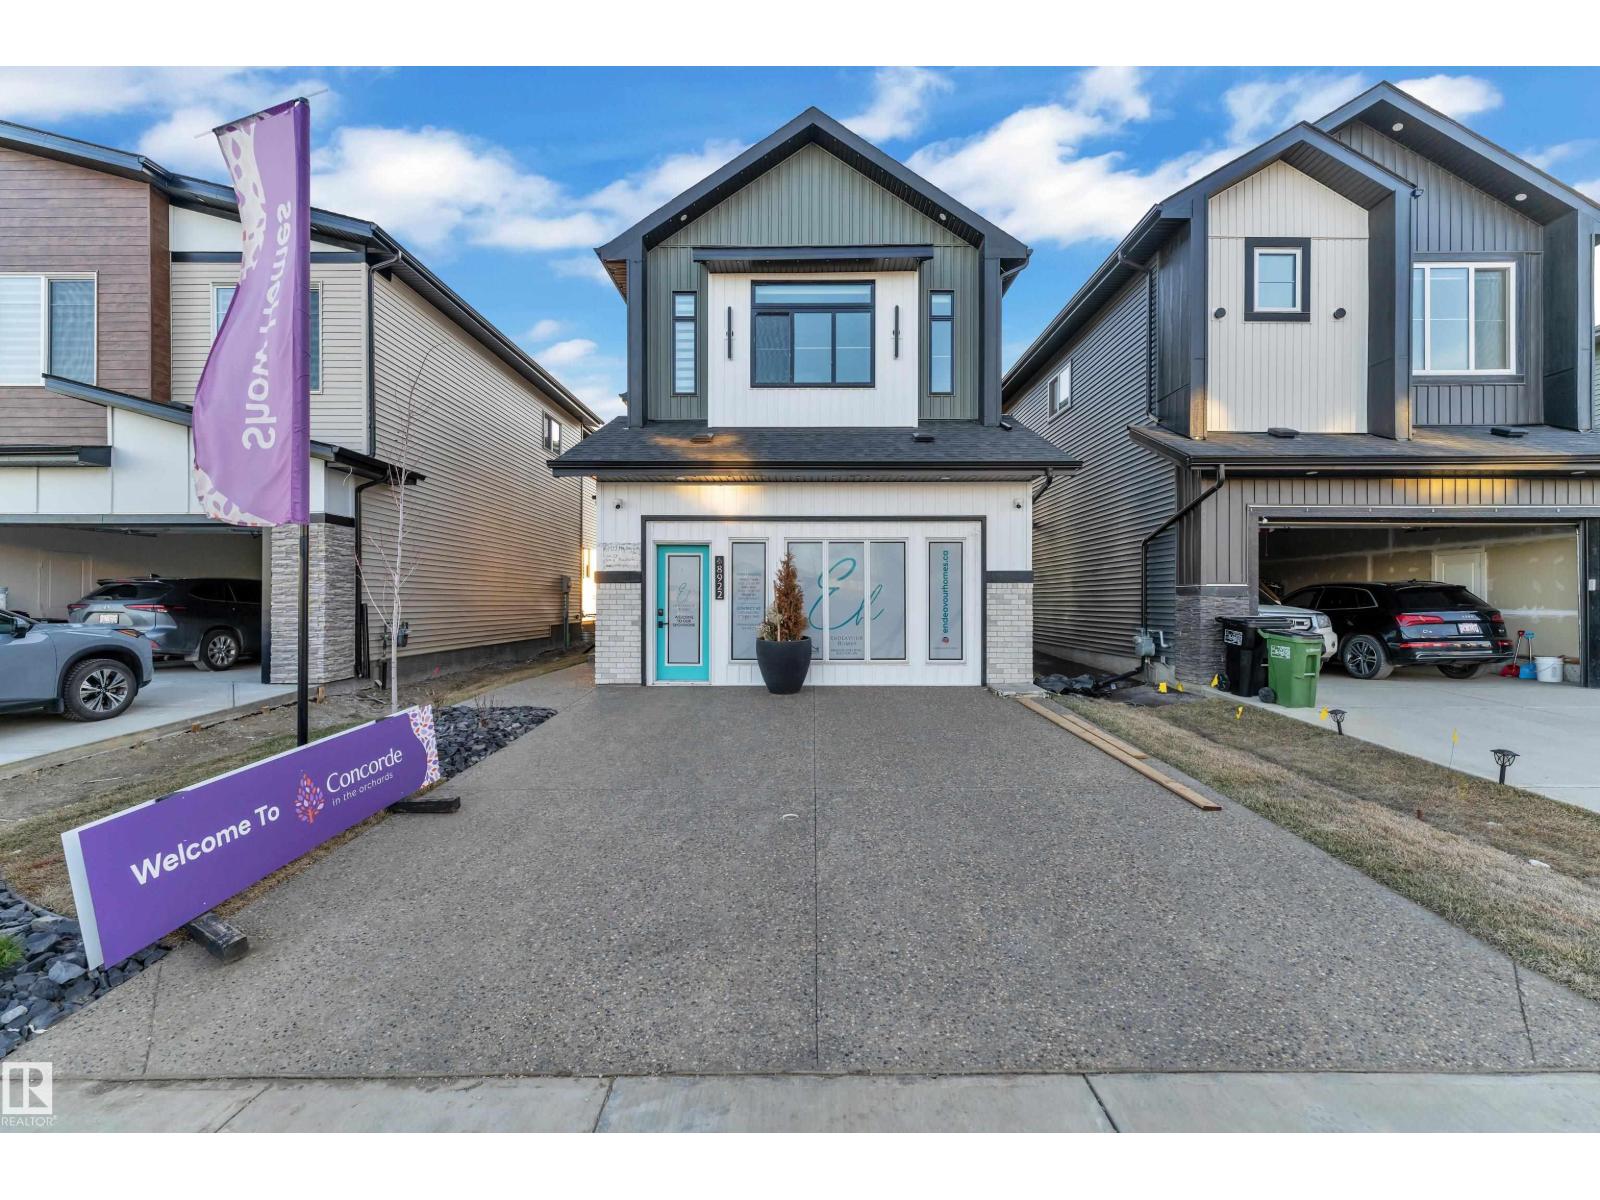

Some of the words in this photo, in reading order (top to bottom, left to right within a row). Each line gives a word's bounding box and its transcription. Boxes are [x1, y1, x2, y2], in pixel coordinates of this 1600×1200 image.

[326, 747, 403, 793] Concorde
[331, 796, 341, 807] in
[343, 788, 357, 801] the
[358, 771, 394, 793] orchards
[129, 817, 252, 885] Welcome
[253, 803, 281, 827] To
